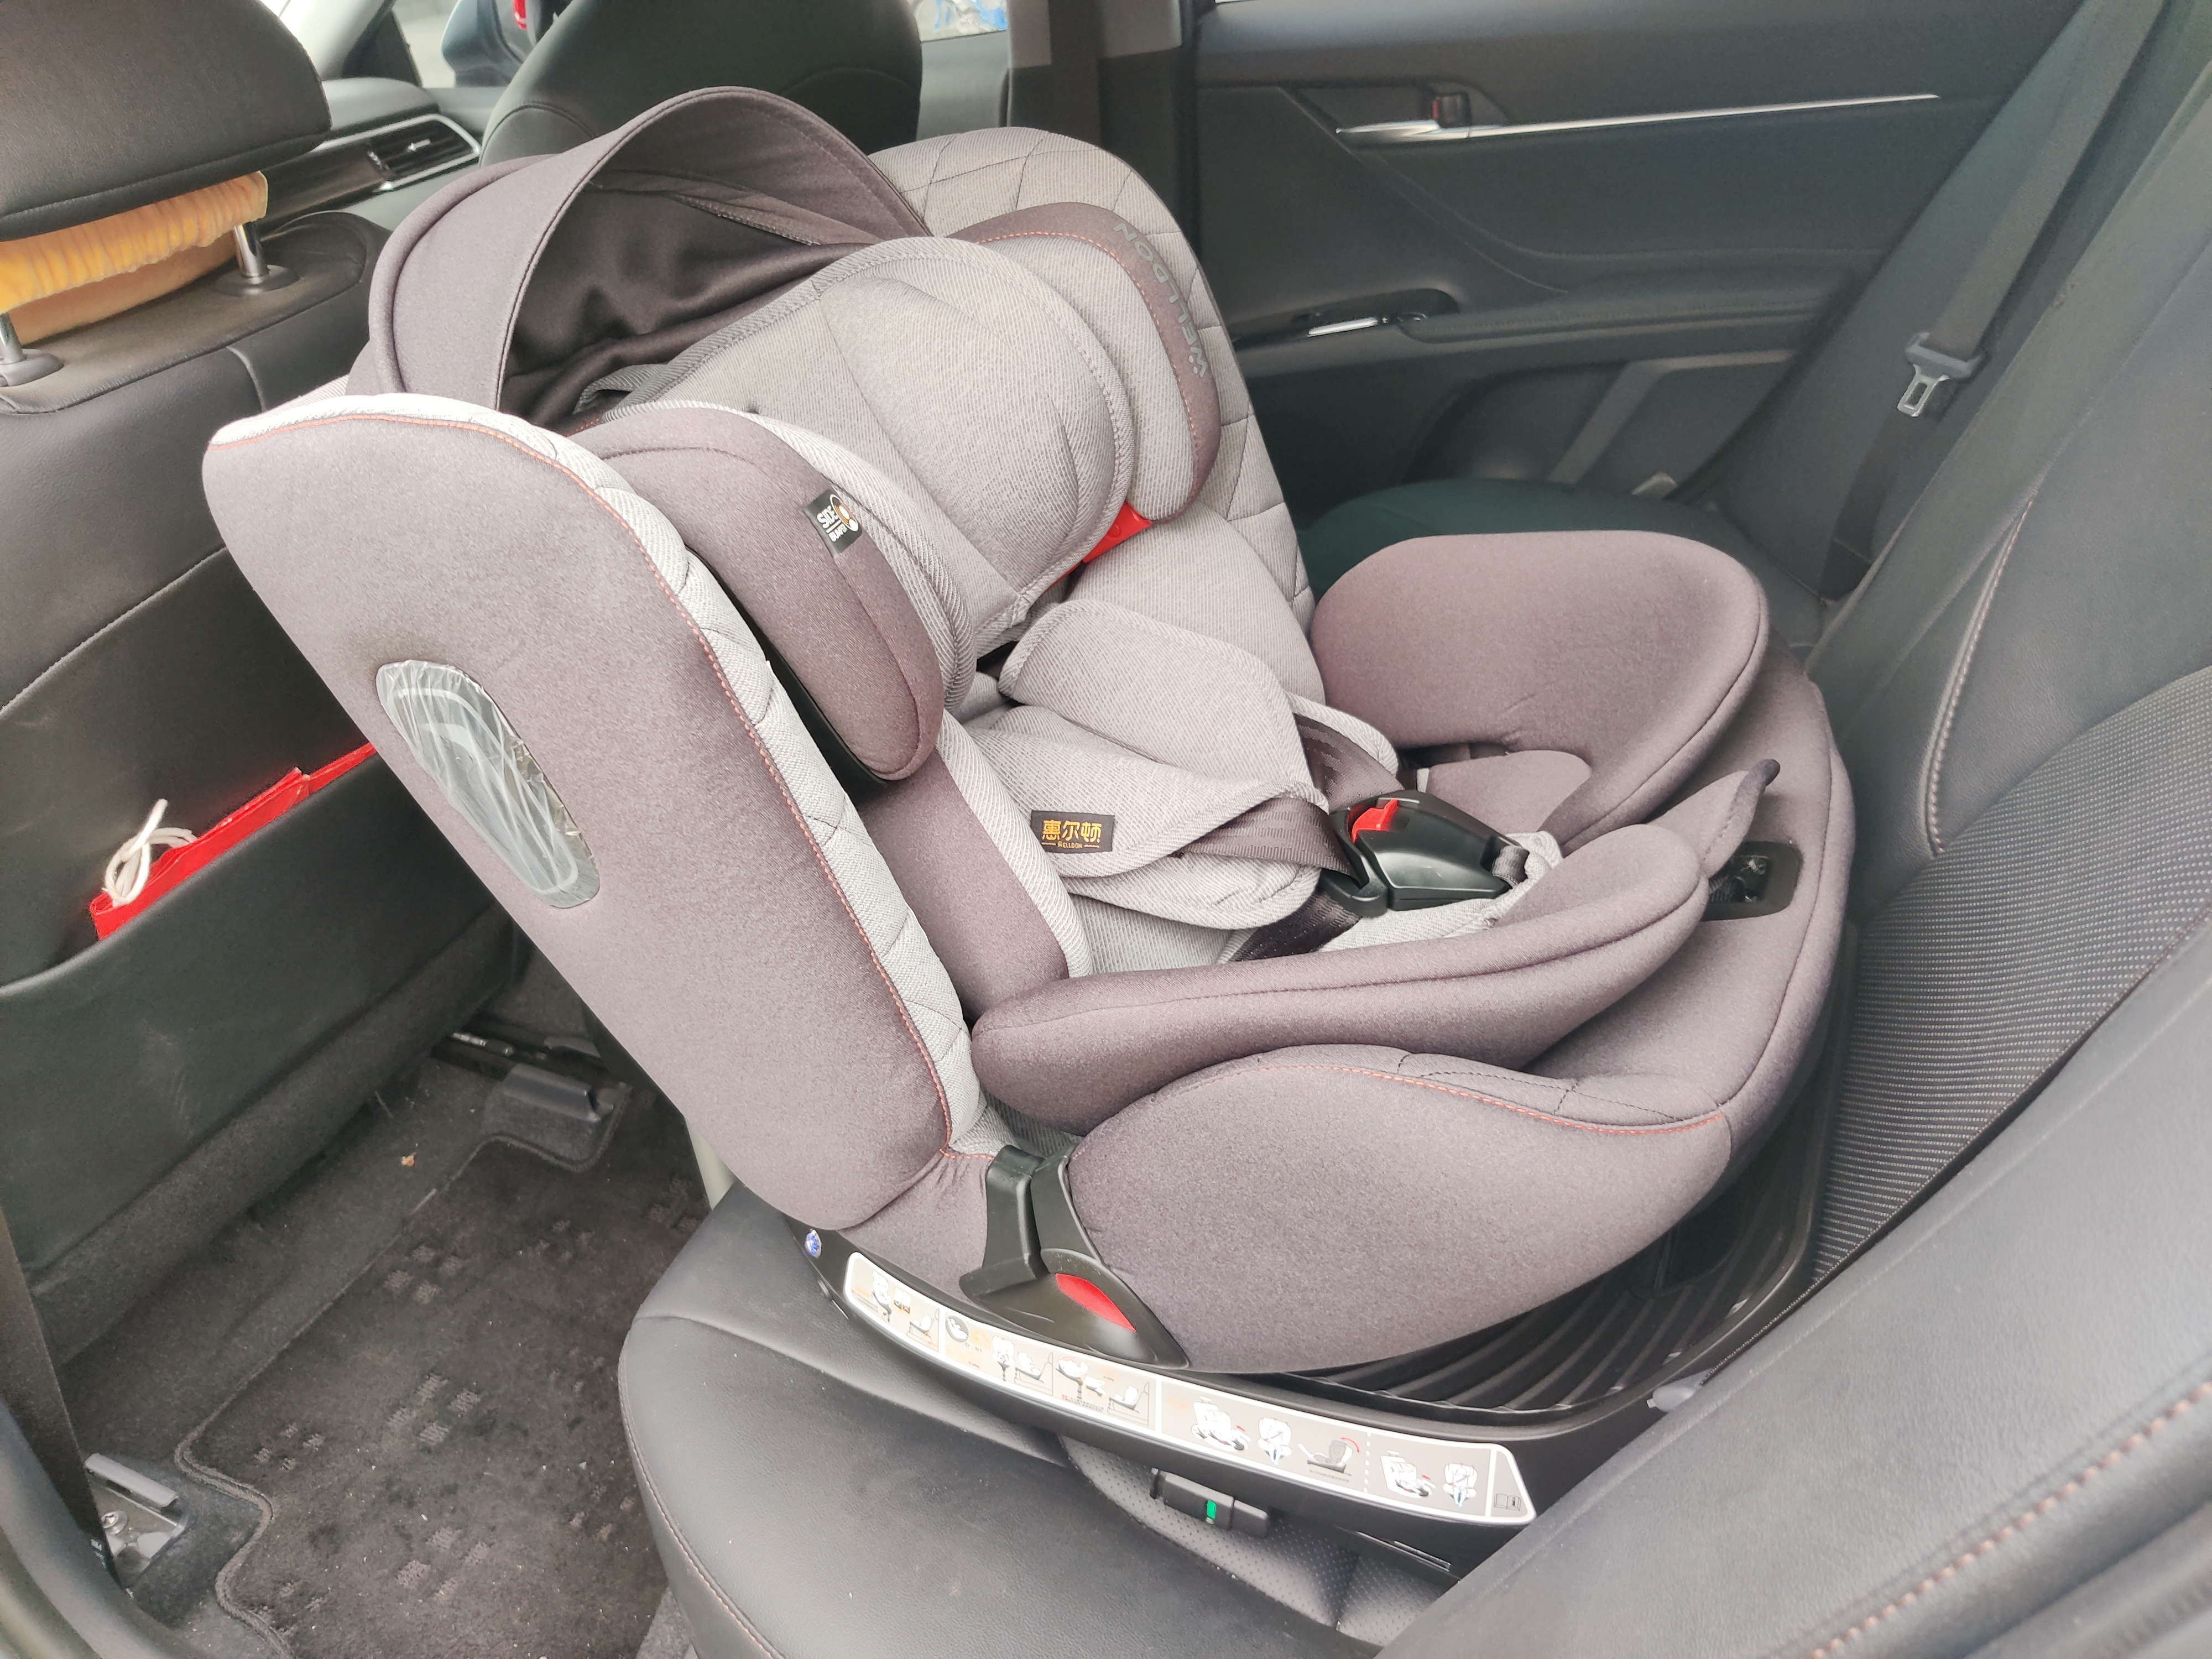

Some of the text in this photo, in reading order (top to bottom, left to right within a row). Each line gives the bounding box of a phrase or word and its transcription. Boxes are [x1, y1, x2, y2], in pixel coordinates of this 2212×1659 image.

[1114, 223, 1206, 378] WELLDON
[817, 506, 839, 529] SIDE
[1042, 820, 1102, 843] 惠尔顿
